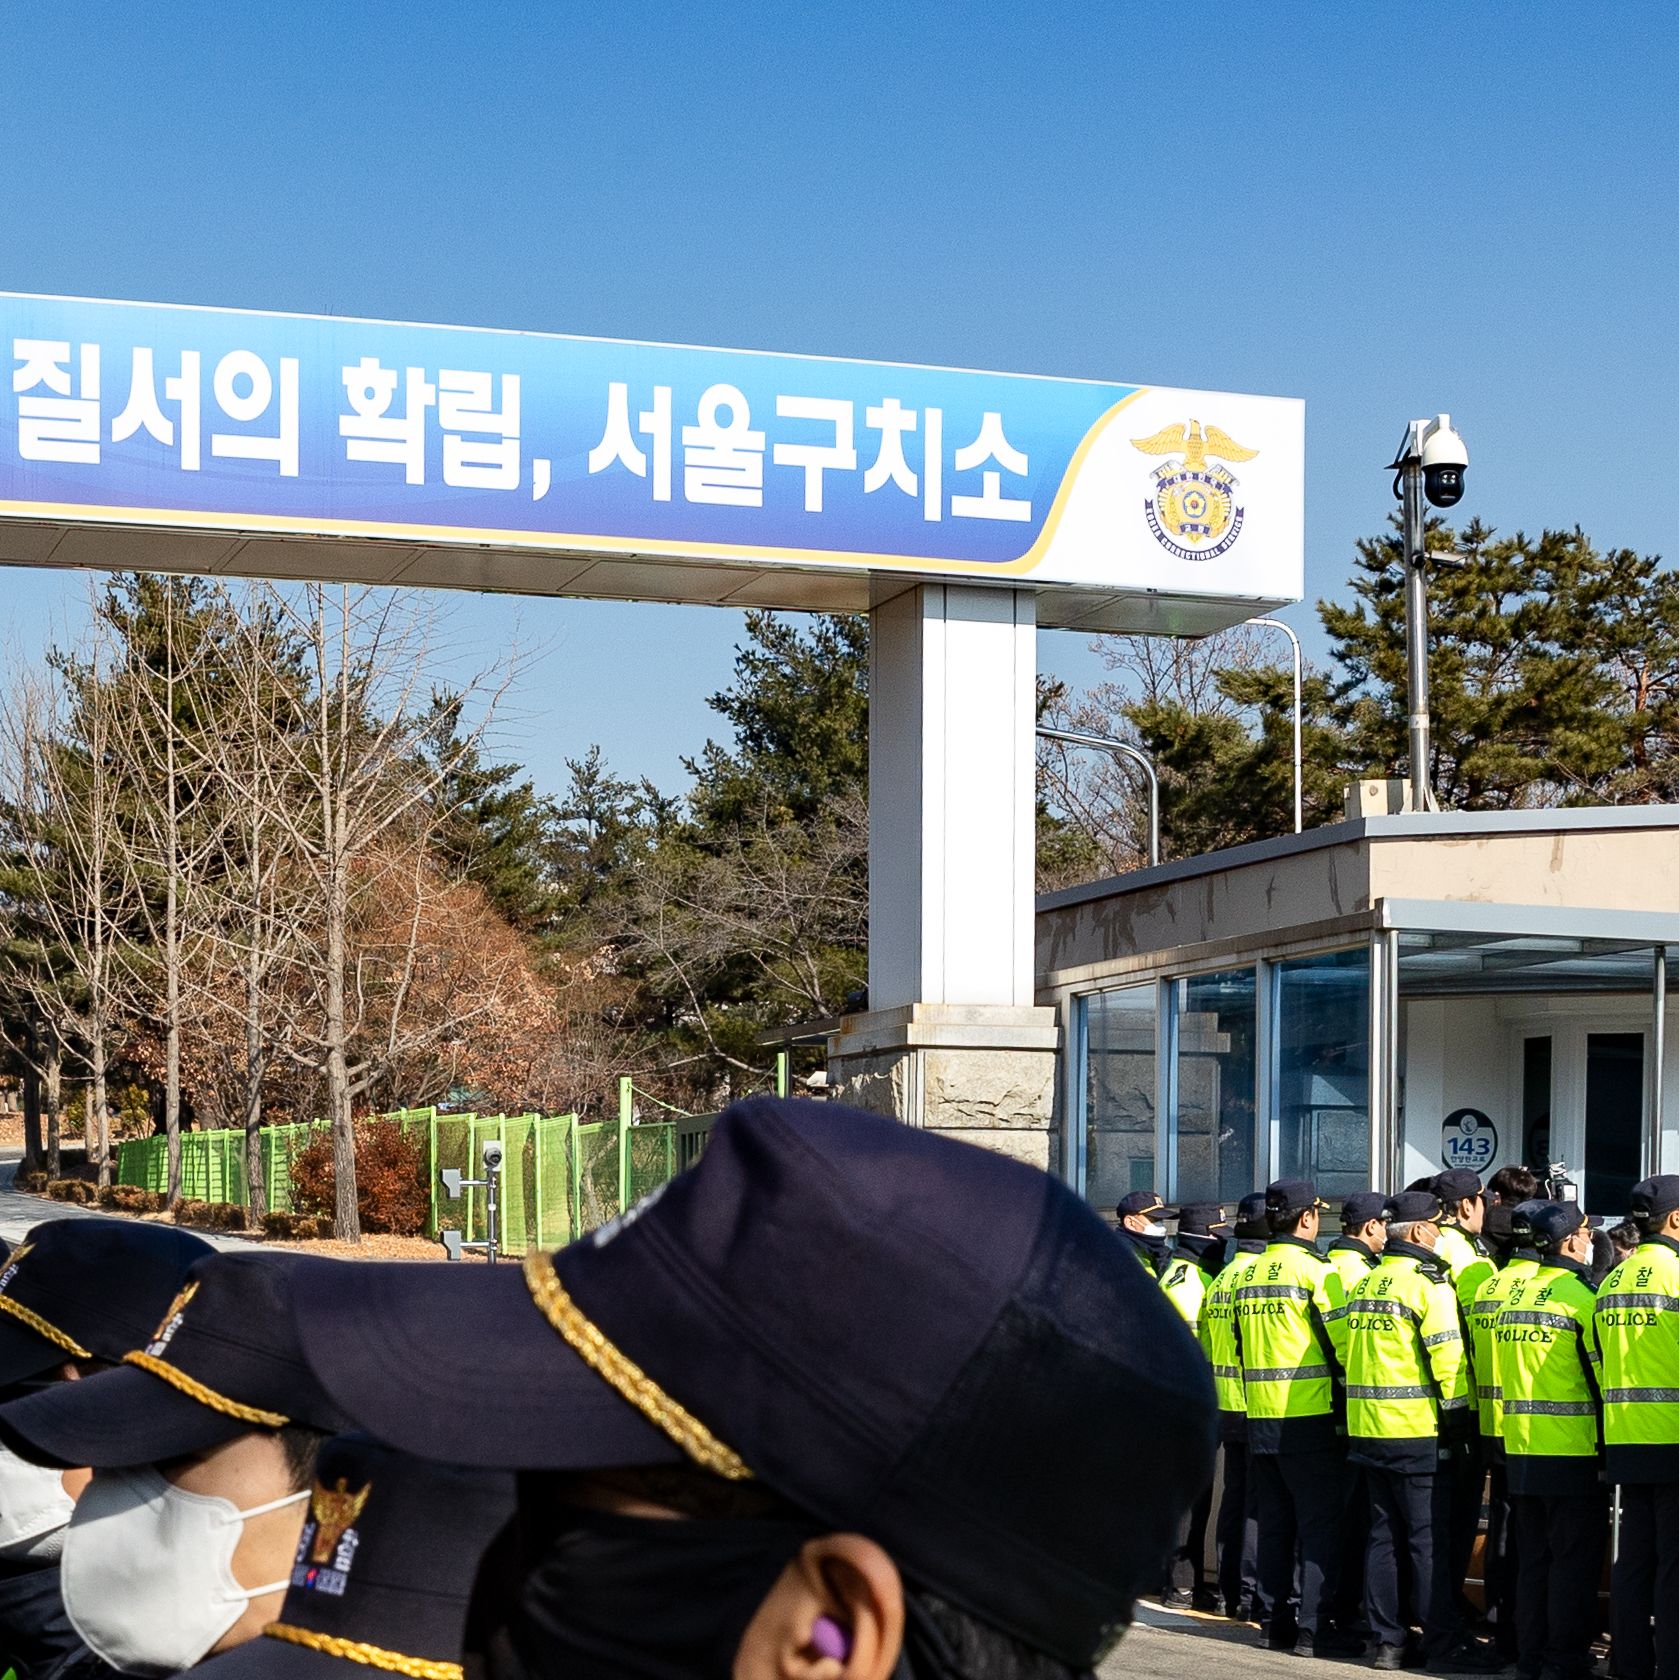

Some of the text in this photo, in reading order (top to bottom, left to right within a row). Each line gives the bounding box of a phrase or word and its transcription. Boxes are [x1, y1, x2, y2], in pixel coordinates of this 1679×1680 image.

[12, 338, 300, 477] 질서의
[338, 357, 553, 502] 확립,
[588, 382, 1033, 523] 서울구치소
[1447, 1137, 1490, 1155] 143
